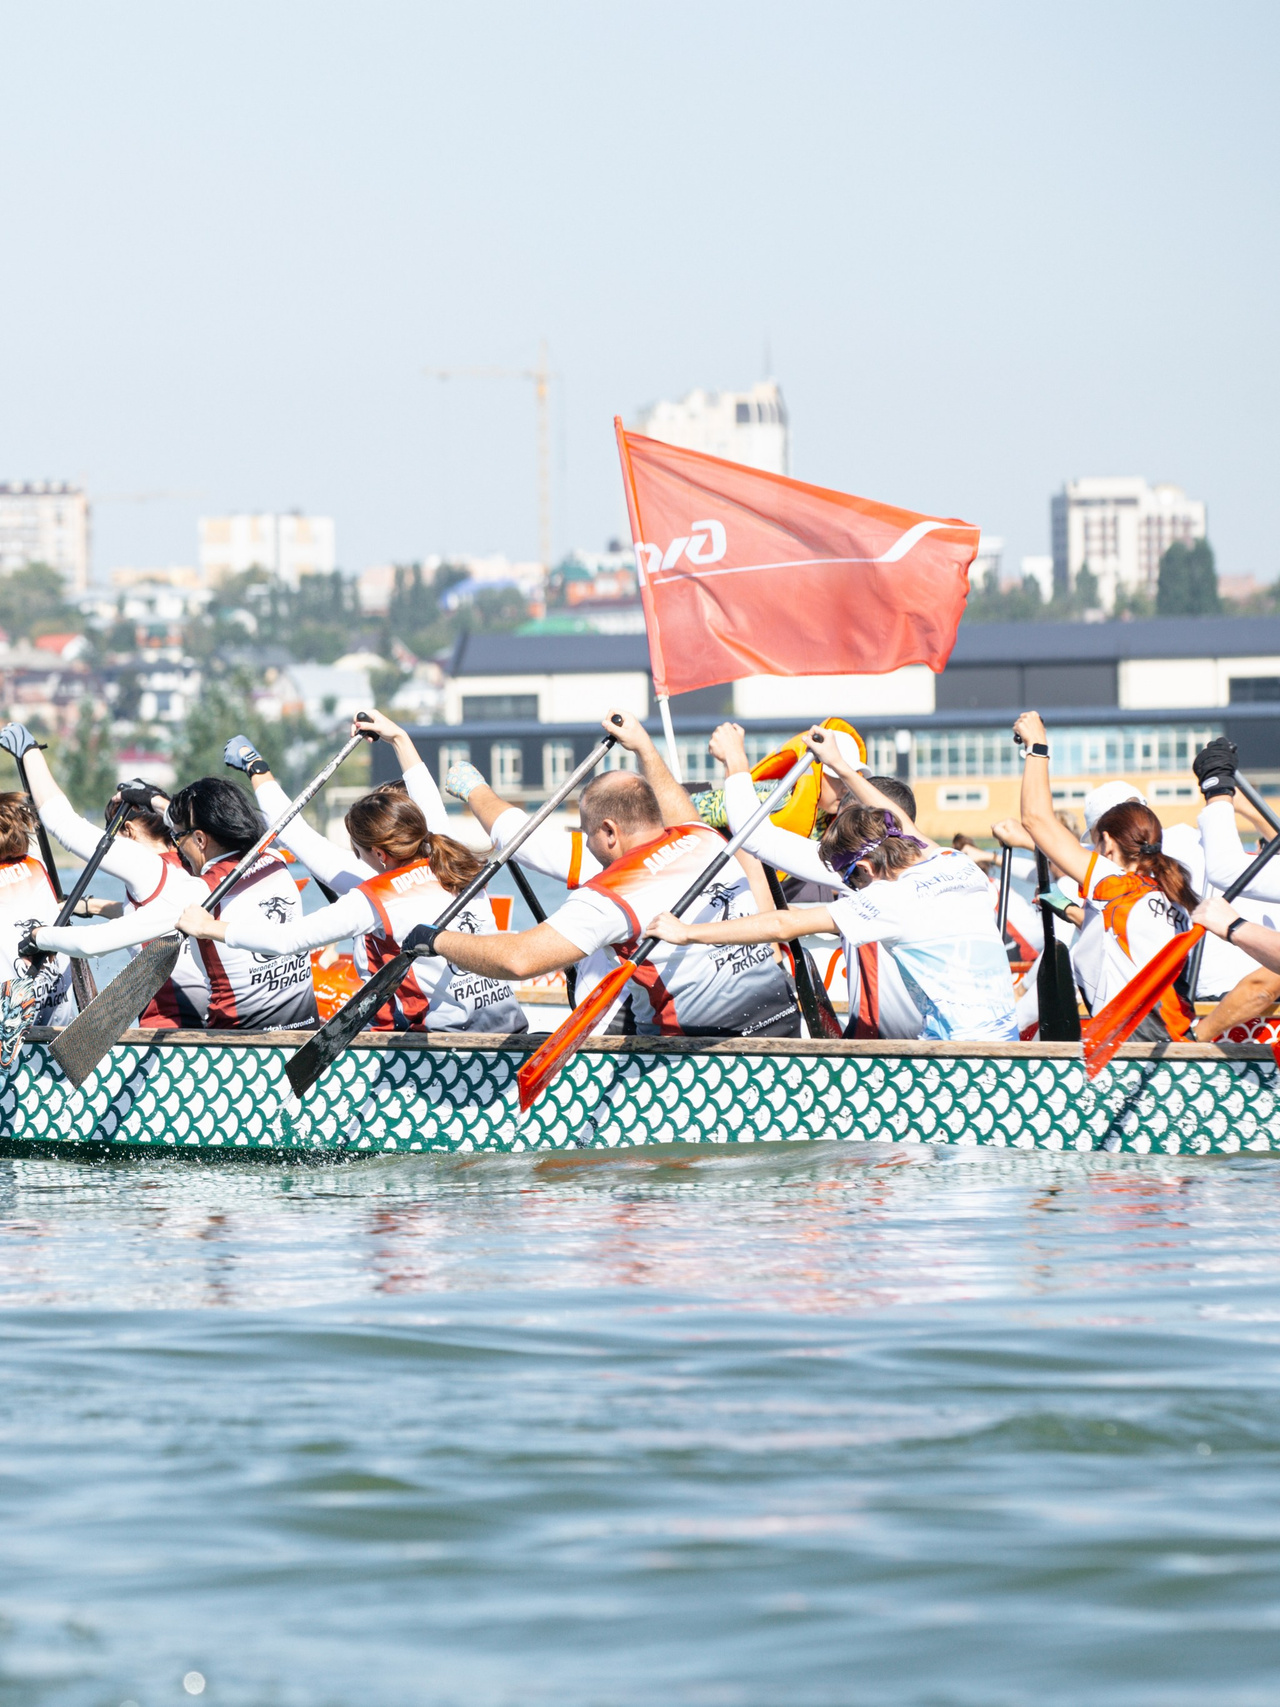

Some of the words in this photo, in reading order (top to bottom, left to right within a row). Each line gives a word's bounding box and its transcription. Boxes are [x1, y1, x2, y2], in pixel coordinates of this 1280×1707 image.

[390, 865, 436, 895] ПРОХ
[1148, 898, 1190, 933] ФЕН
[251, 957, 306, 986] RACING
[268, 966, 311, 992] DRAGO
[454, 978, 500, 1002] RACING
